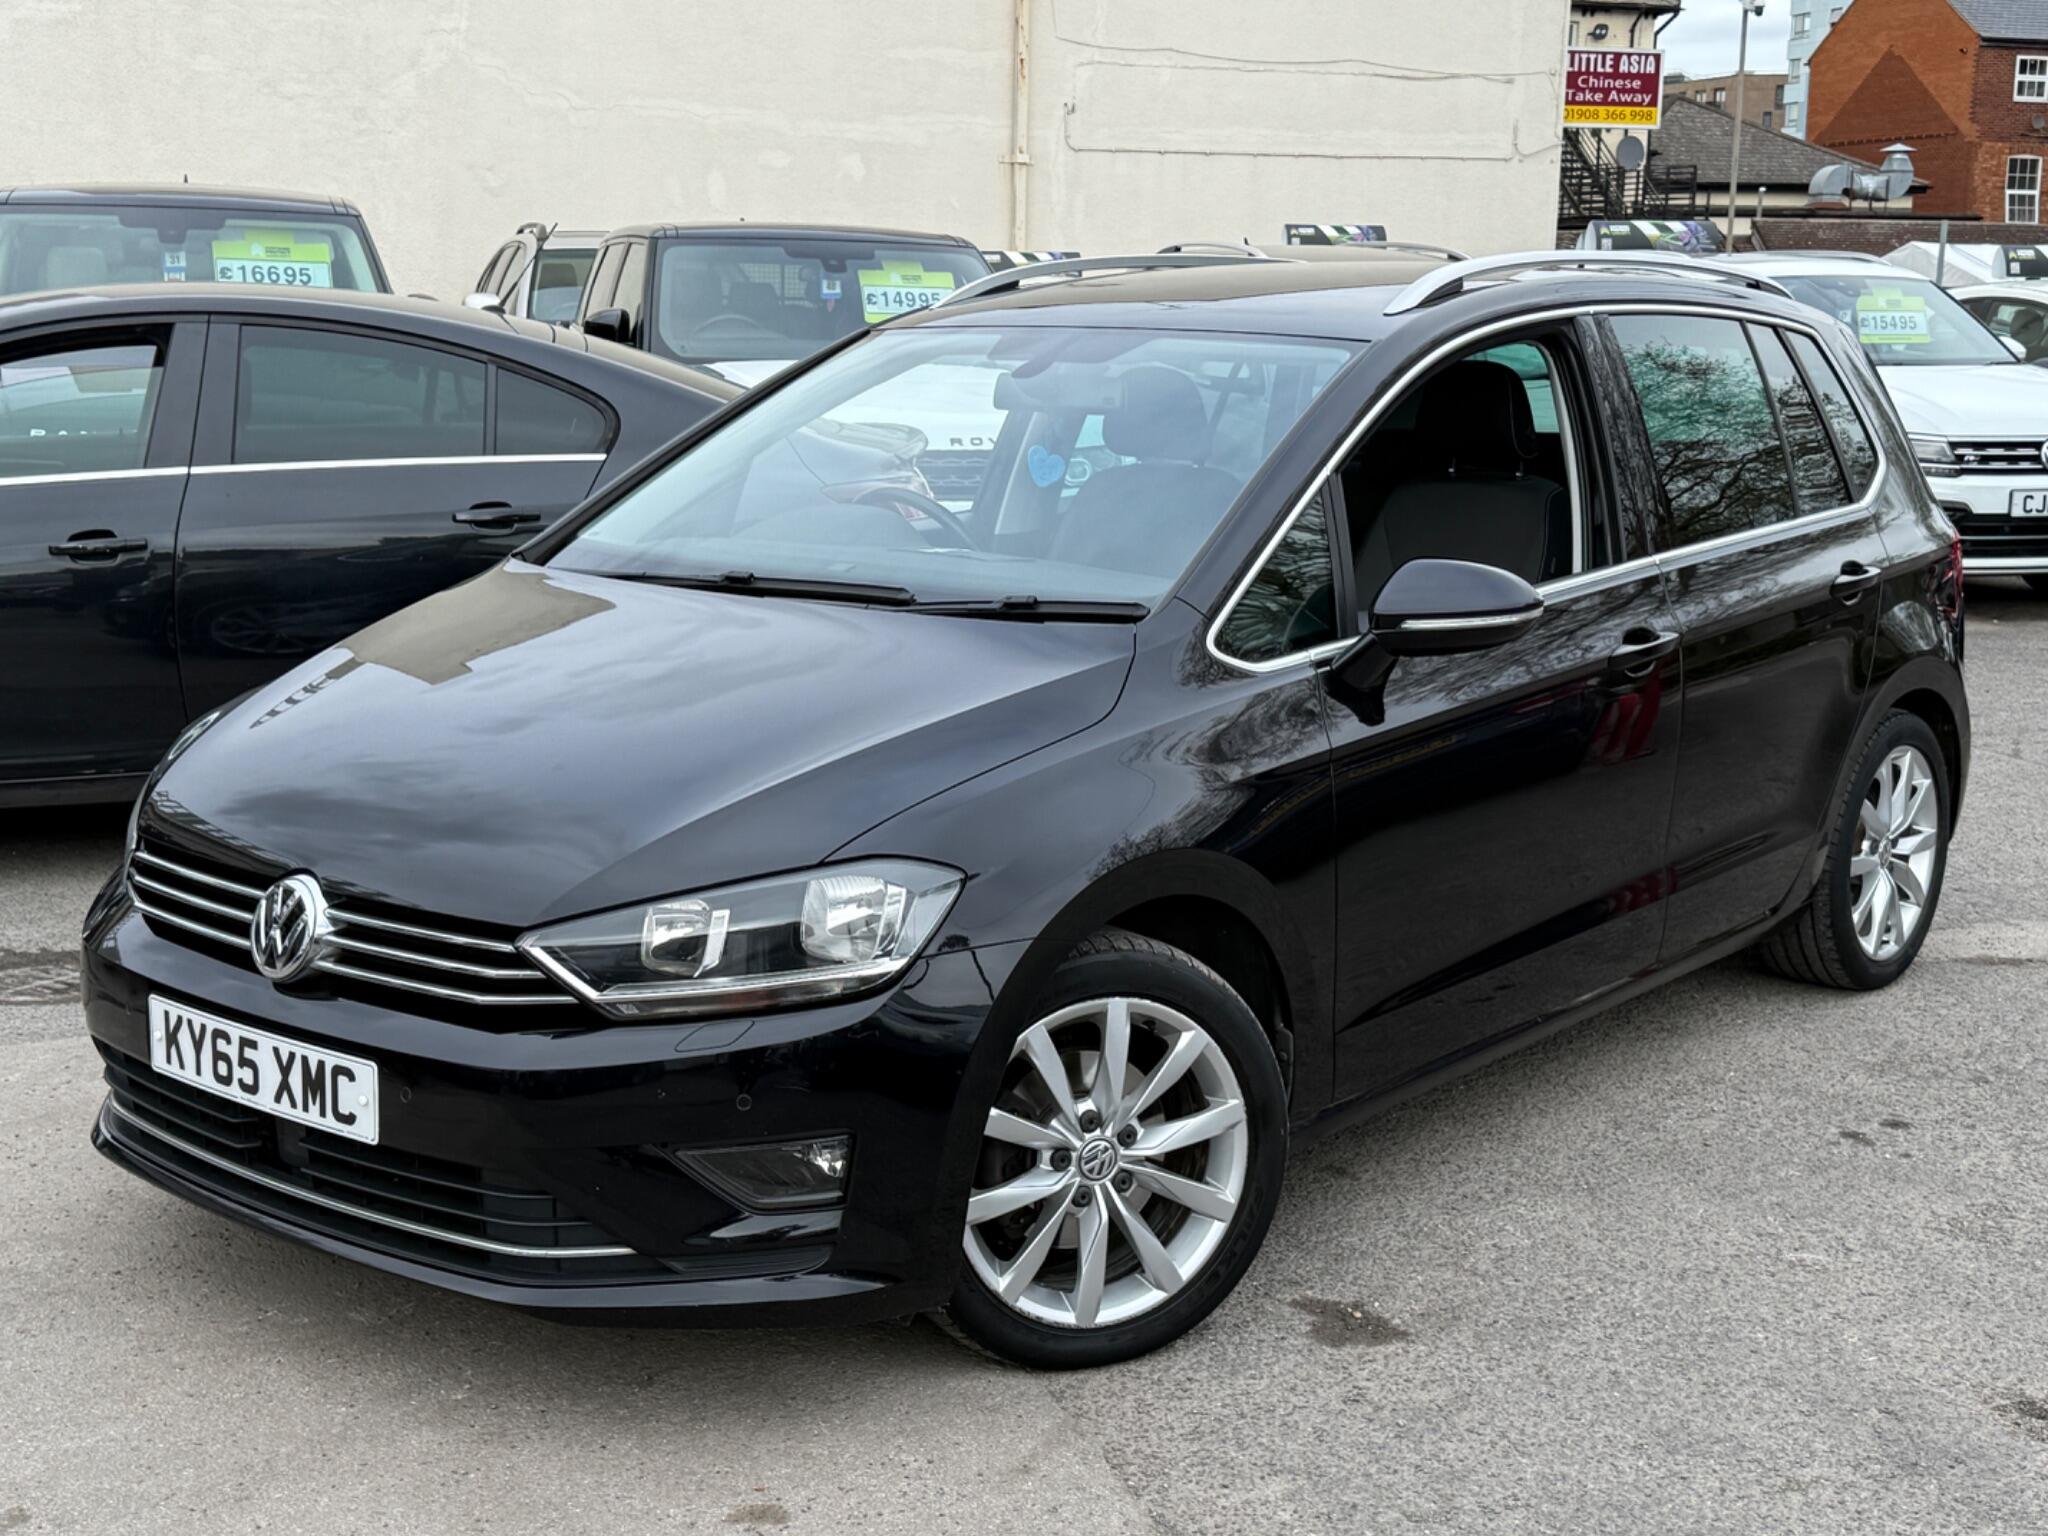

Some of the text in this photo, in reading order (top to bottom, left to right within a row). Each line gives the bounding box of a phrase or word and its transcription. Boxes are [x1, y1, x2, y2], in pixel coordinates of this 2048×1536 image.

[1567, 53, 1656, 74] LITTLE ASIA
[1577, 75, 1642, 90] Chinese
[1566, 89, 1652, 106] Take Away
[1564, 108, 1654, 122] 01908 366 998
[219, 264, 312, 286] £16695
[1860, 315, 1918, 331] £15495
[2023, 494, 2048, 513] CJ
[164, 1009, 357, 1127] KY65 XMC
